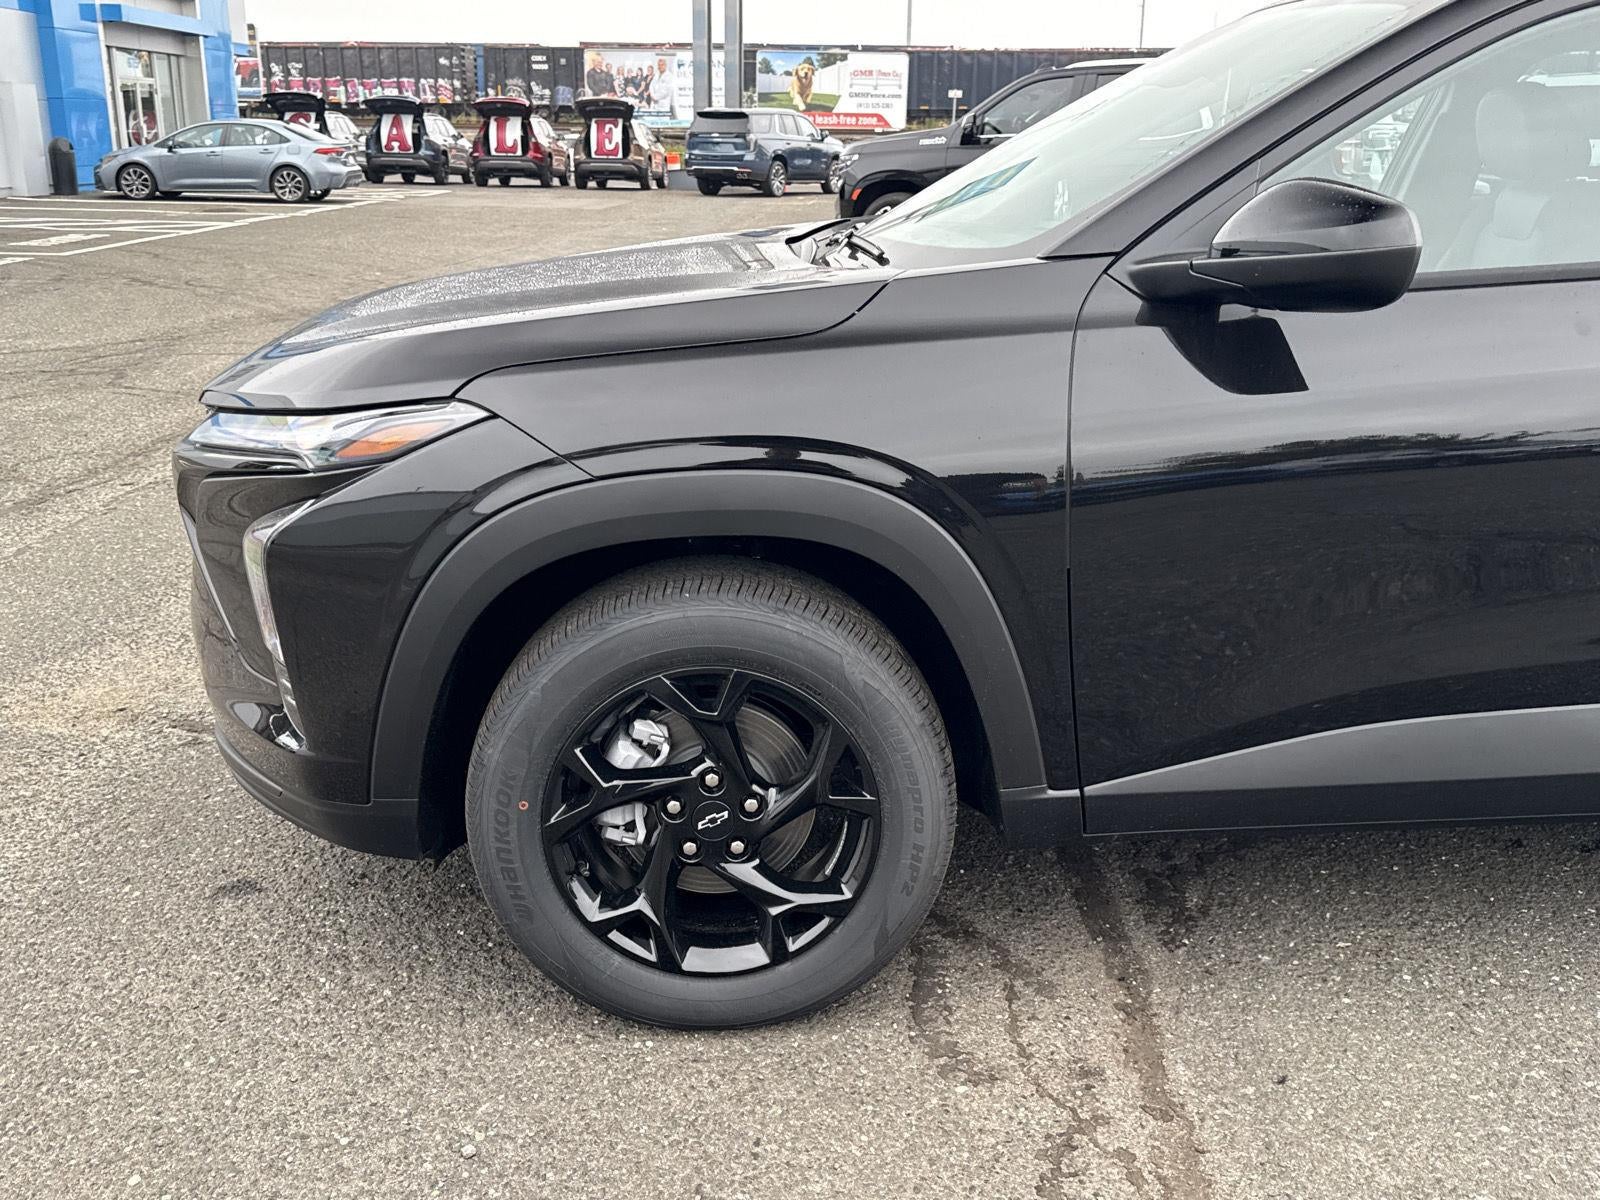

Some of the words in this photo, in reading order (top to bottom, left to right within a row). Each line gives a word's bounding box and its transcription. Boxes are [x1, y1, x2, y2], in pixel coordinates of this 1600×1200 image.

[384, 114, 411, 152] A
[494, 116, 518, 154] L
[594, 118, 619, 156] E
[815, 113, 857, 125] leash-free
